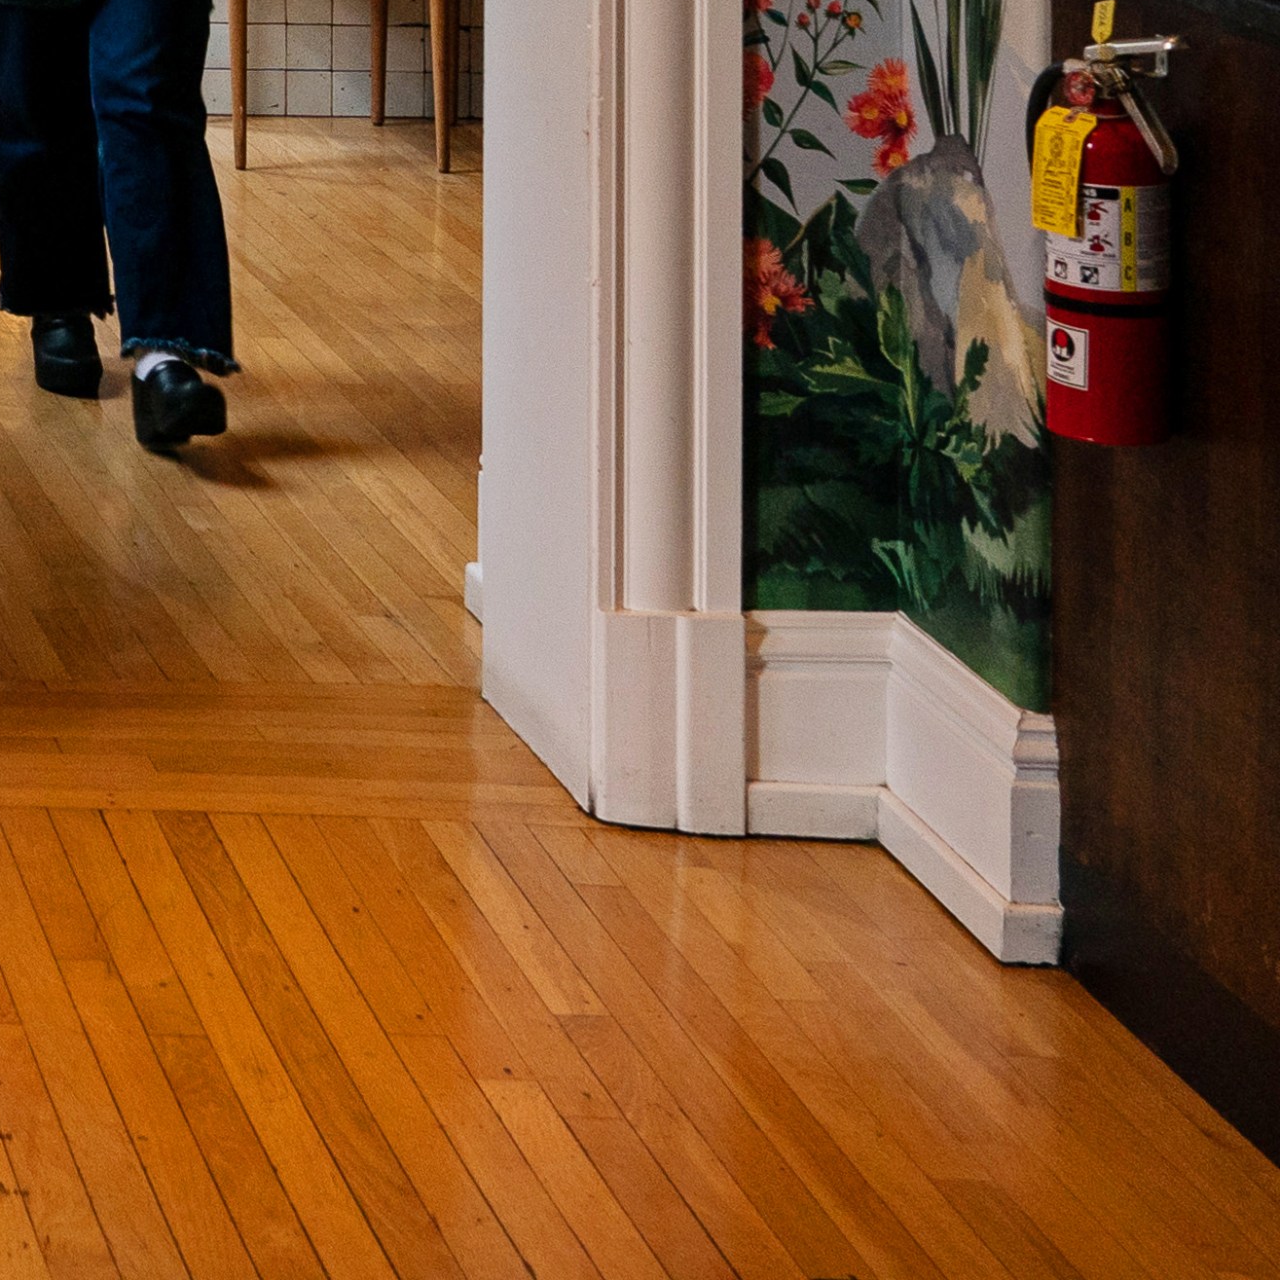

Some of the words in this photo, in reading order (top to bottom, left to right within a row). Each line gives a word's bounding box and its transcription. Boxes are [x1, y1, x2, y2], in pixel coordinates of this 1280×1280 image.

[1124, 197, 1132, 212] A
[1124, 232, 1132, 246] B
[1124, 265, 1132, 280] C
